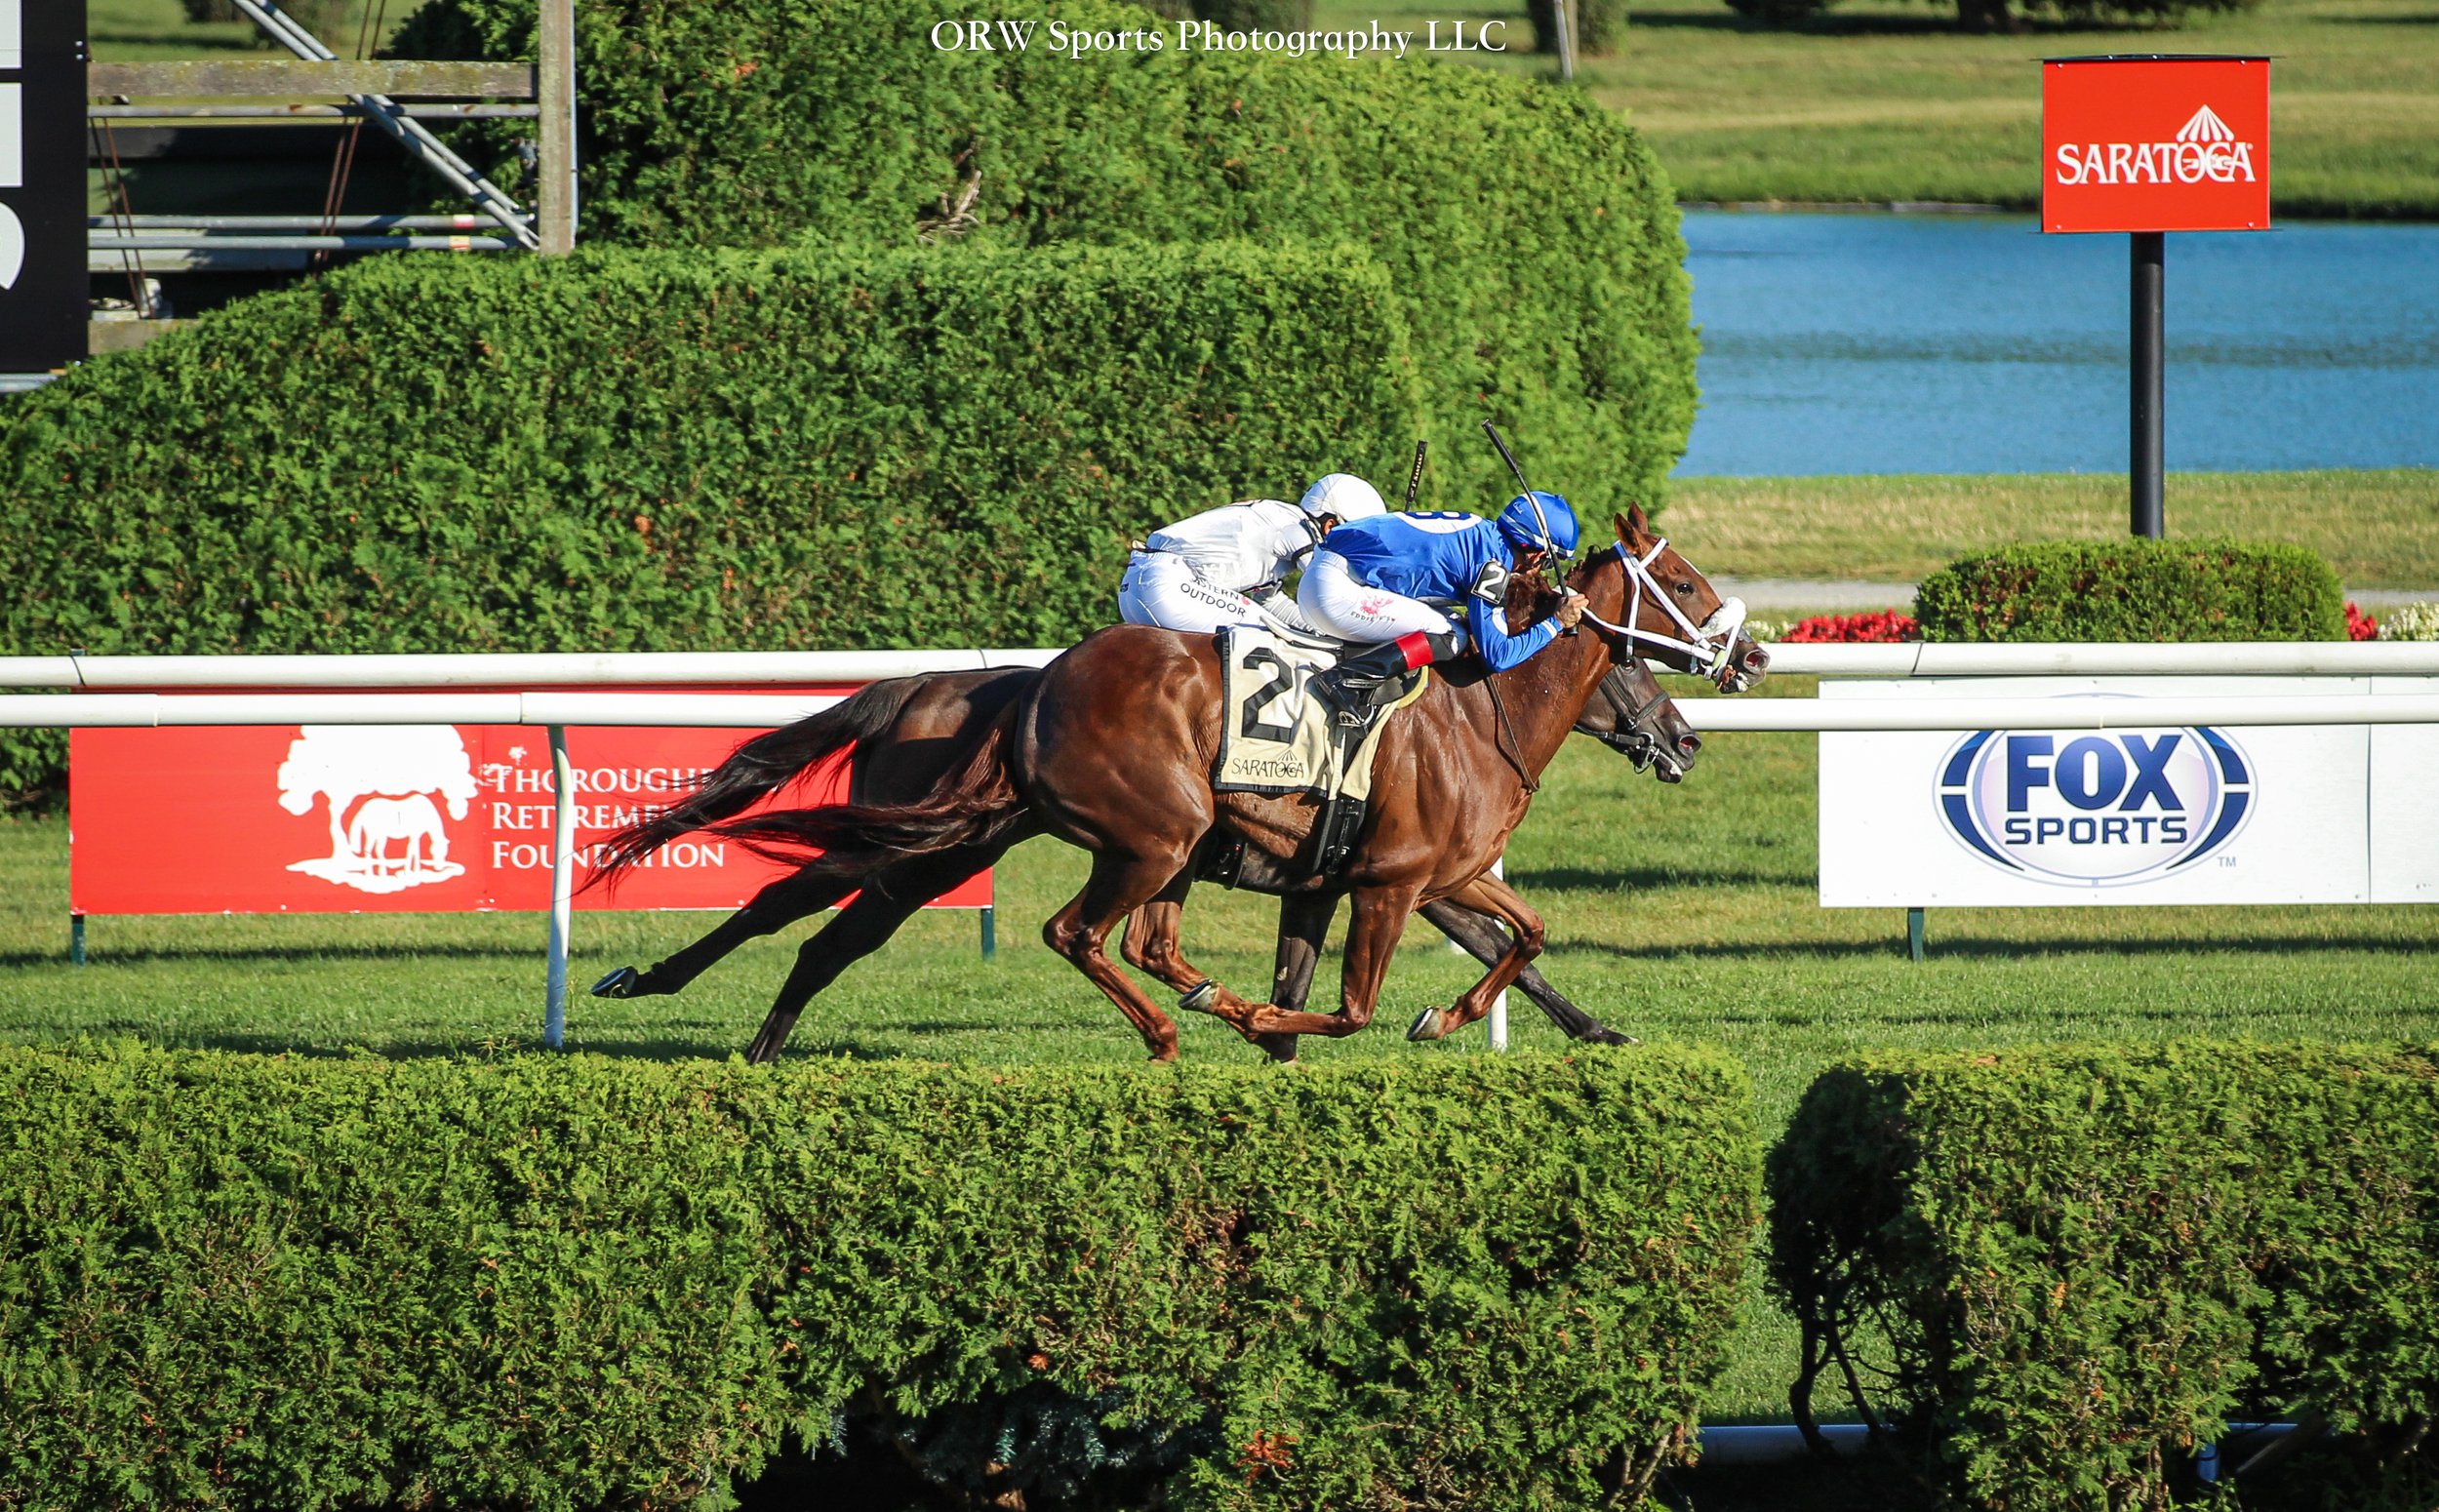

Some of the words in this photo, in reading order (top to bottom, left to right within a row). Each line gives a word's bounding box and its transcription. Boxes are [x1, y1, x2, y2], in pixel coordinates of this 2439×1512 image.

[2056, 141, 2257, 185] SARATOGA
[1180, 582, 1247, 617] OUTDOOR
[1190, 577, 1239, 601] ASTERN
[1477, 564, 1507, 600] 2
[1241, 647, 1294, 744] 2
[1231, 757, 1304, 778] SARATOGA
[2006, 735, 2185, 813] FOX
[2005, 816, 2188, 845] SPORTS
[2217, 856, 2237, 867] TM
